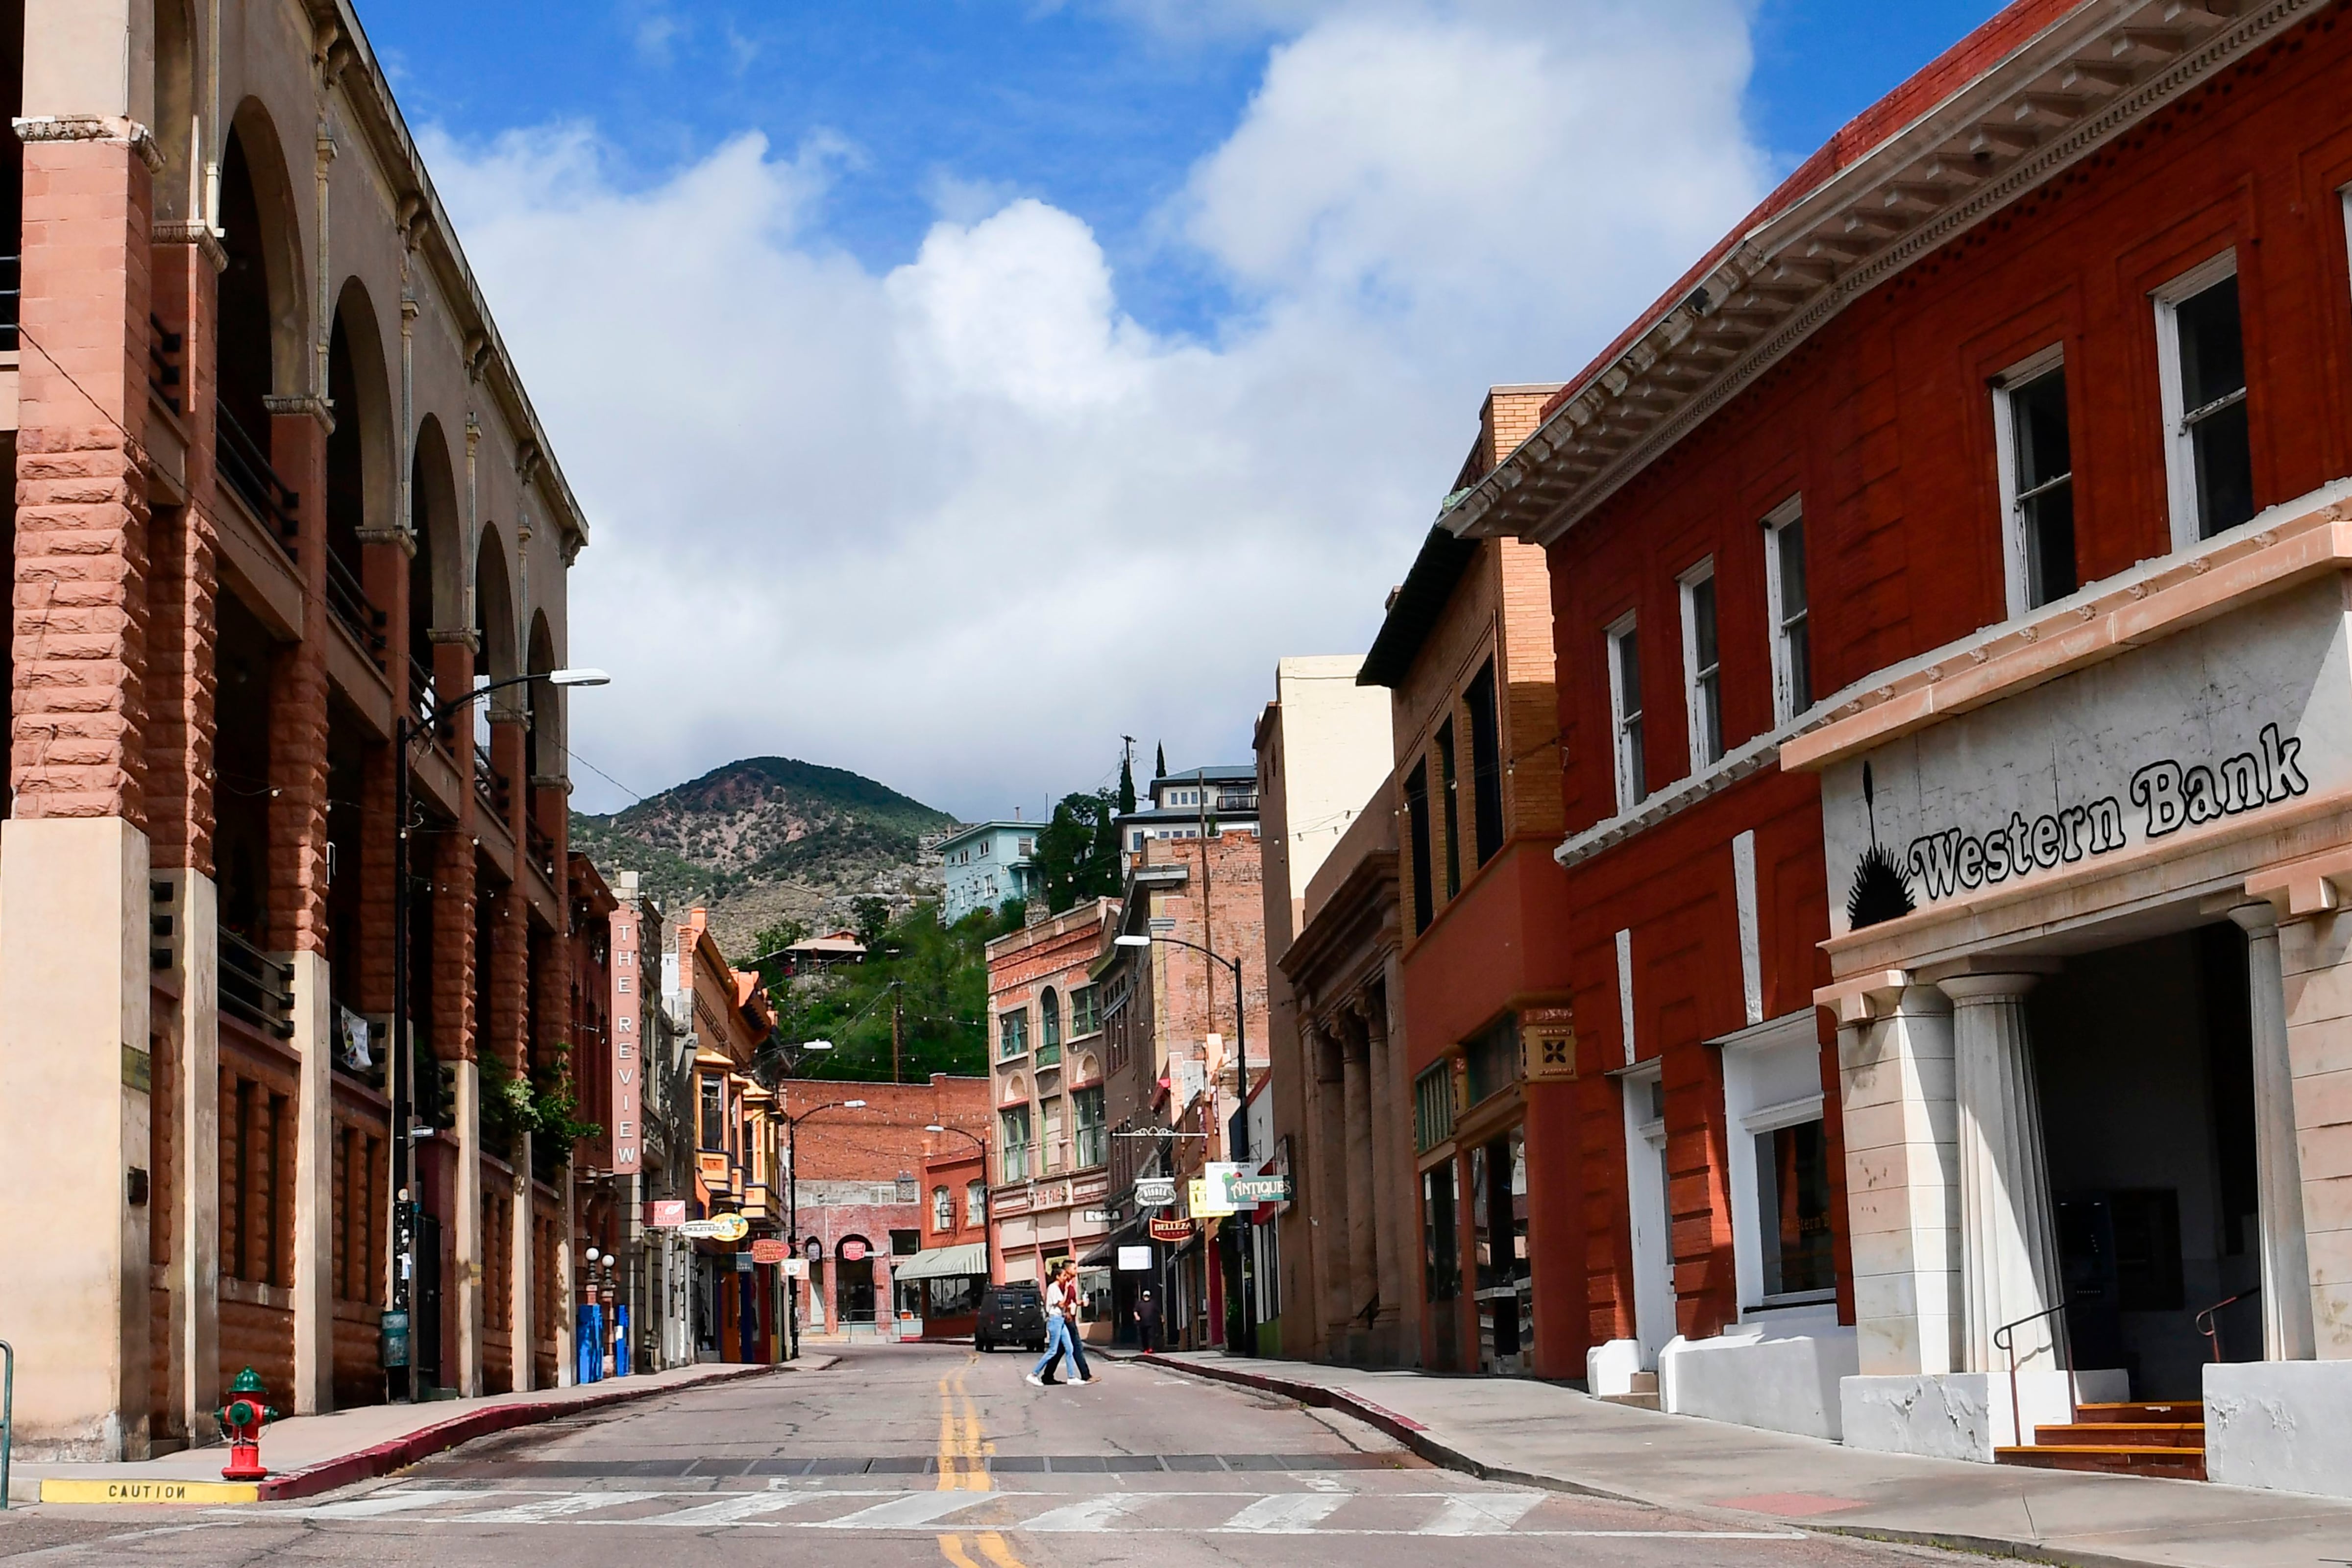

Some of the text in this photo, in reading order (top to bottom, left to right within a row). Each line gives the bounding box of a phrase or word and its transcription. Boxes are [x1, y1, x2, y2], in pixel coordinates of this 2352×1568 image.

[1908, 722, 2309, 900] Western Bank
[617, 924, 636, 1164] THE REVIEW
[1230, 1180, 1292, 1200] ANTIQUES
[1154, 1222, 1192, 1231] BELLEZA
[108, 1485, 185, 1498] CAUTION
